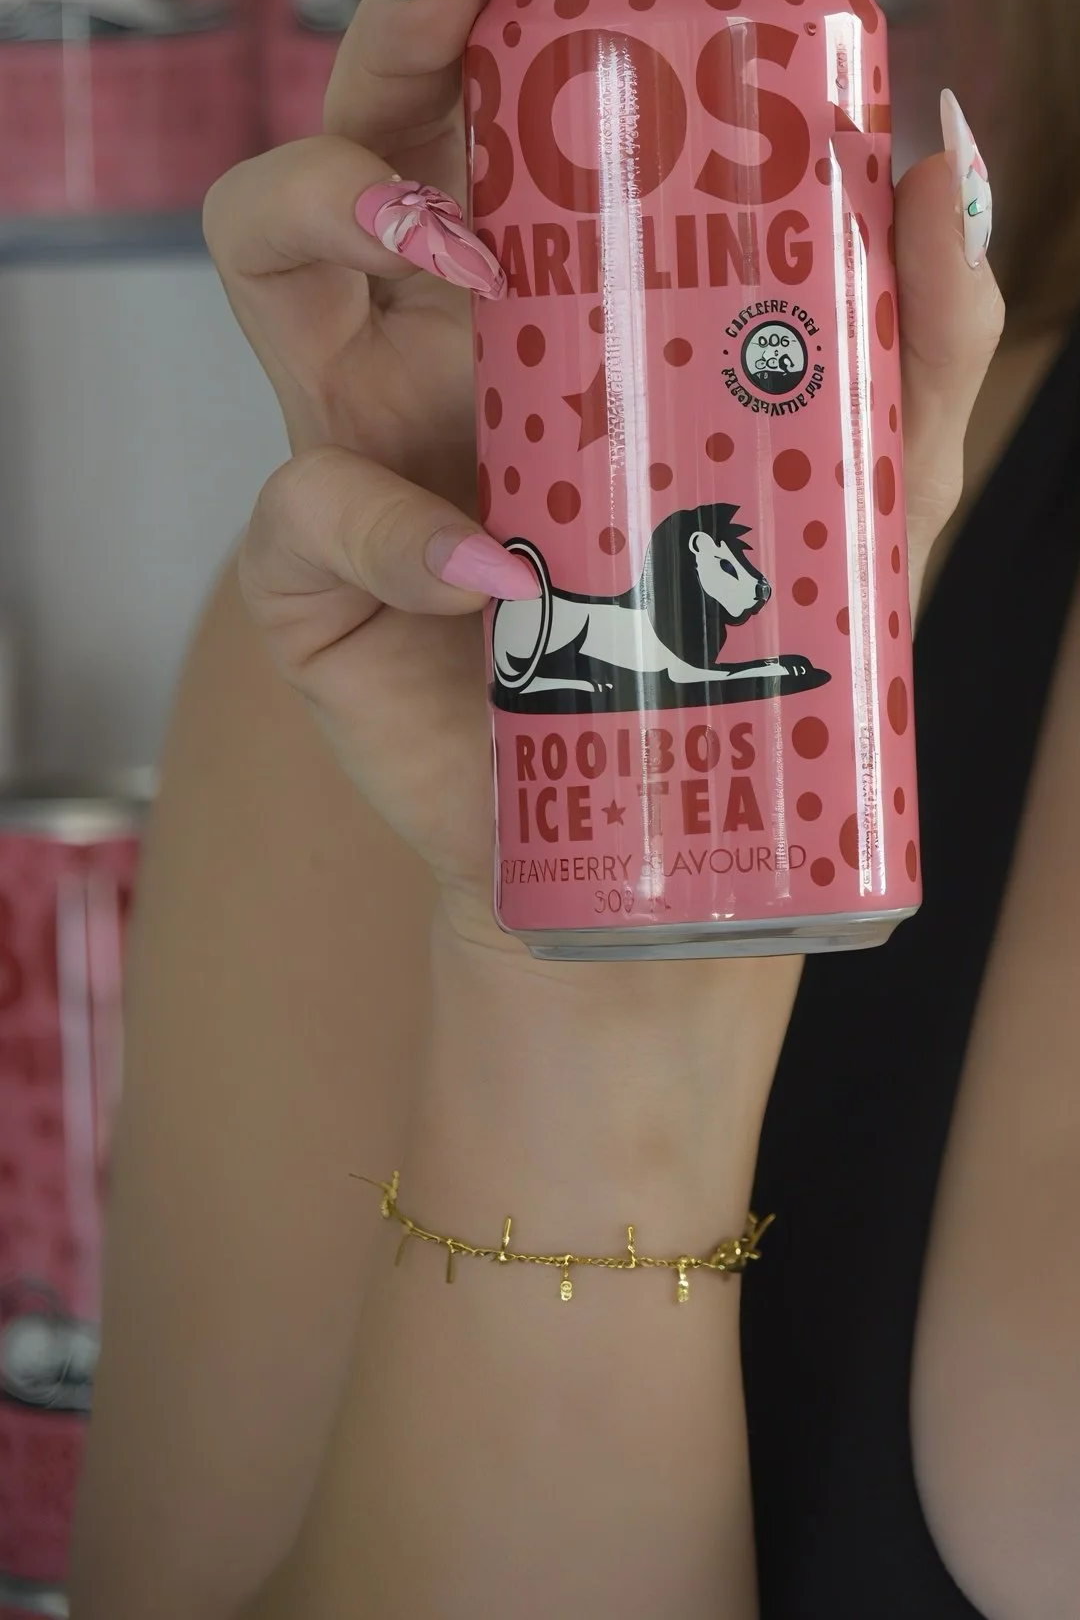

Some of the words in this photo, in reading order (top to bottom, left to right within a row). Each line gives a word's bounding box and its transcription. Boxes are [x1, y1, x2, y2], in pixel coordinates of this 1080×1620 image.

[464, 21, 811, 218] BOS
[515, 722, 757, 781] ROOIBOS
[518, 784, 594, 844] ICE
[637, 776, 765, 836] TEA
